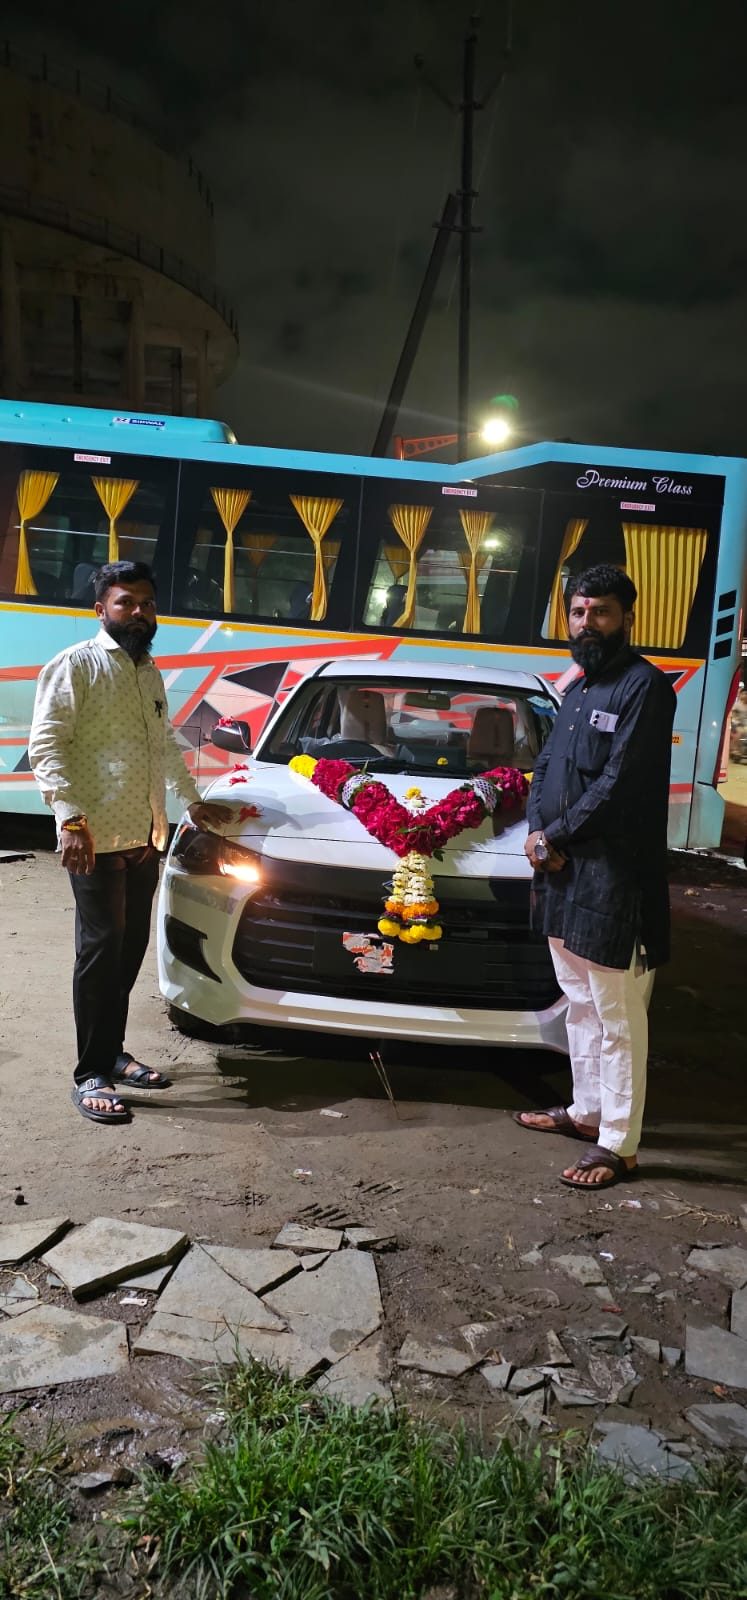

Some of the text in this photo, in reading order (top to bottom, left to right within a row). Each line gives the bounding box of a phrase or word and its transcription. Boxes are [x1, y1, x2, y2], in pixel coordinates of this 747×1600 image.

[75, 453, 99, 462] EMERGENCY
[576, 469, 693, 495] Premium Class
